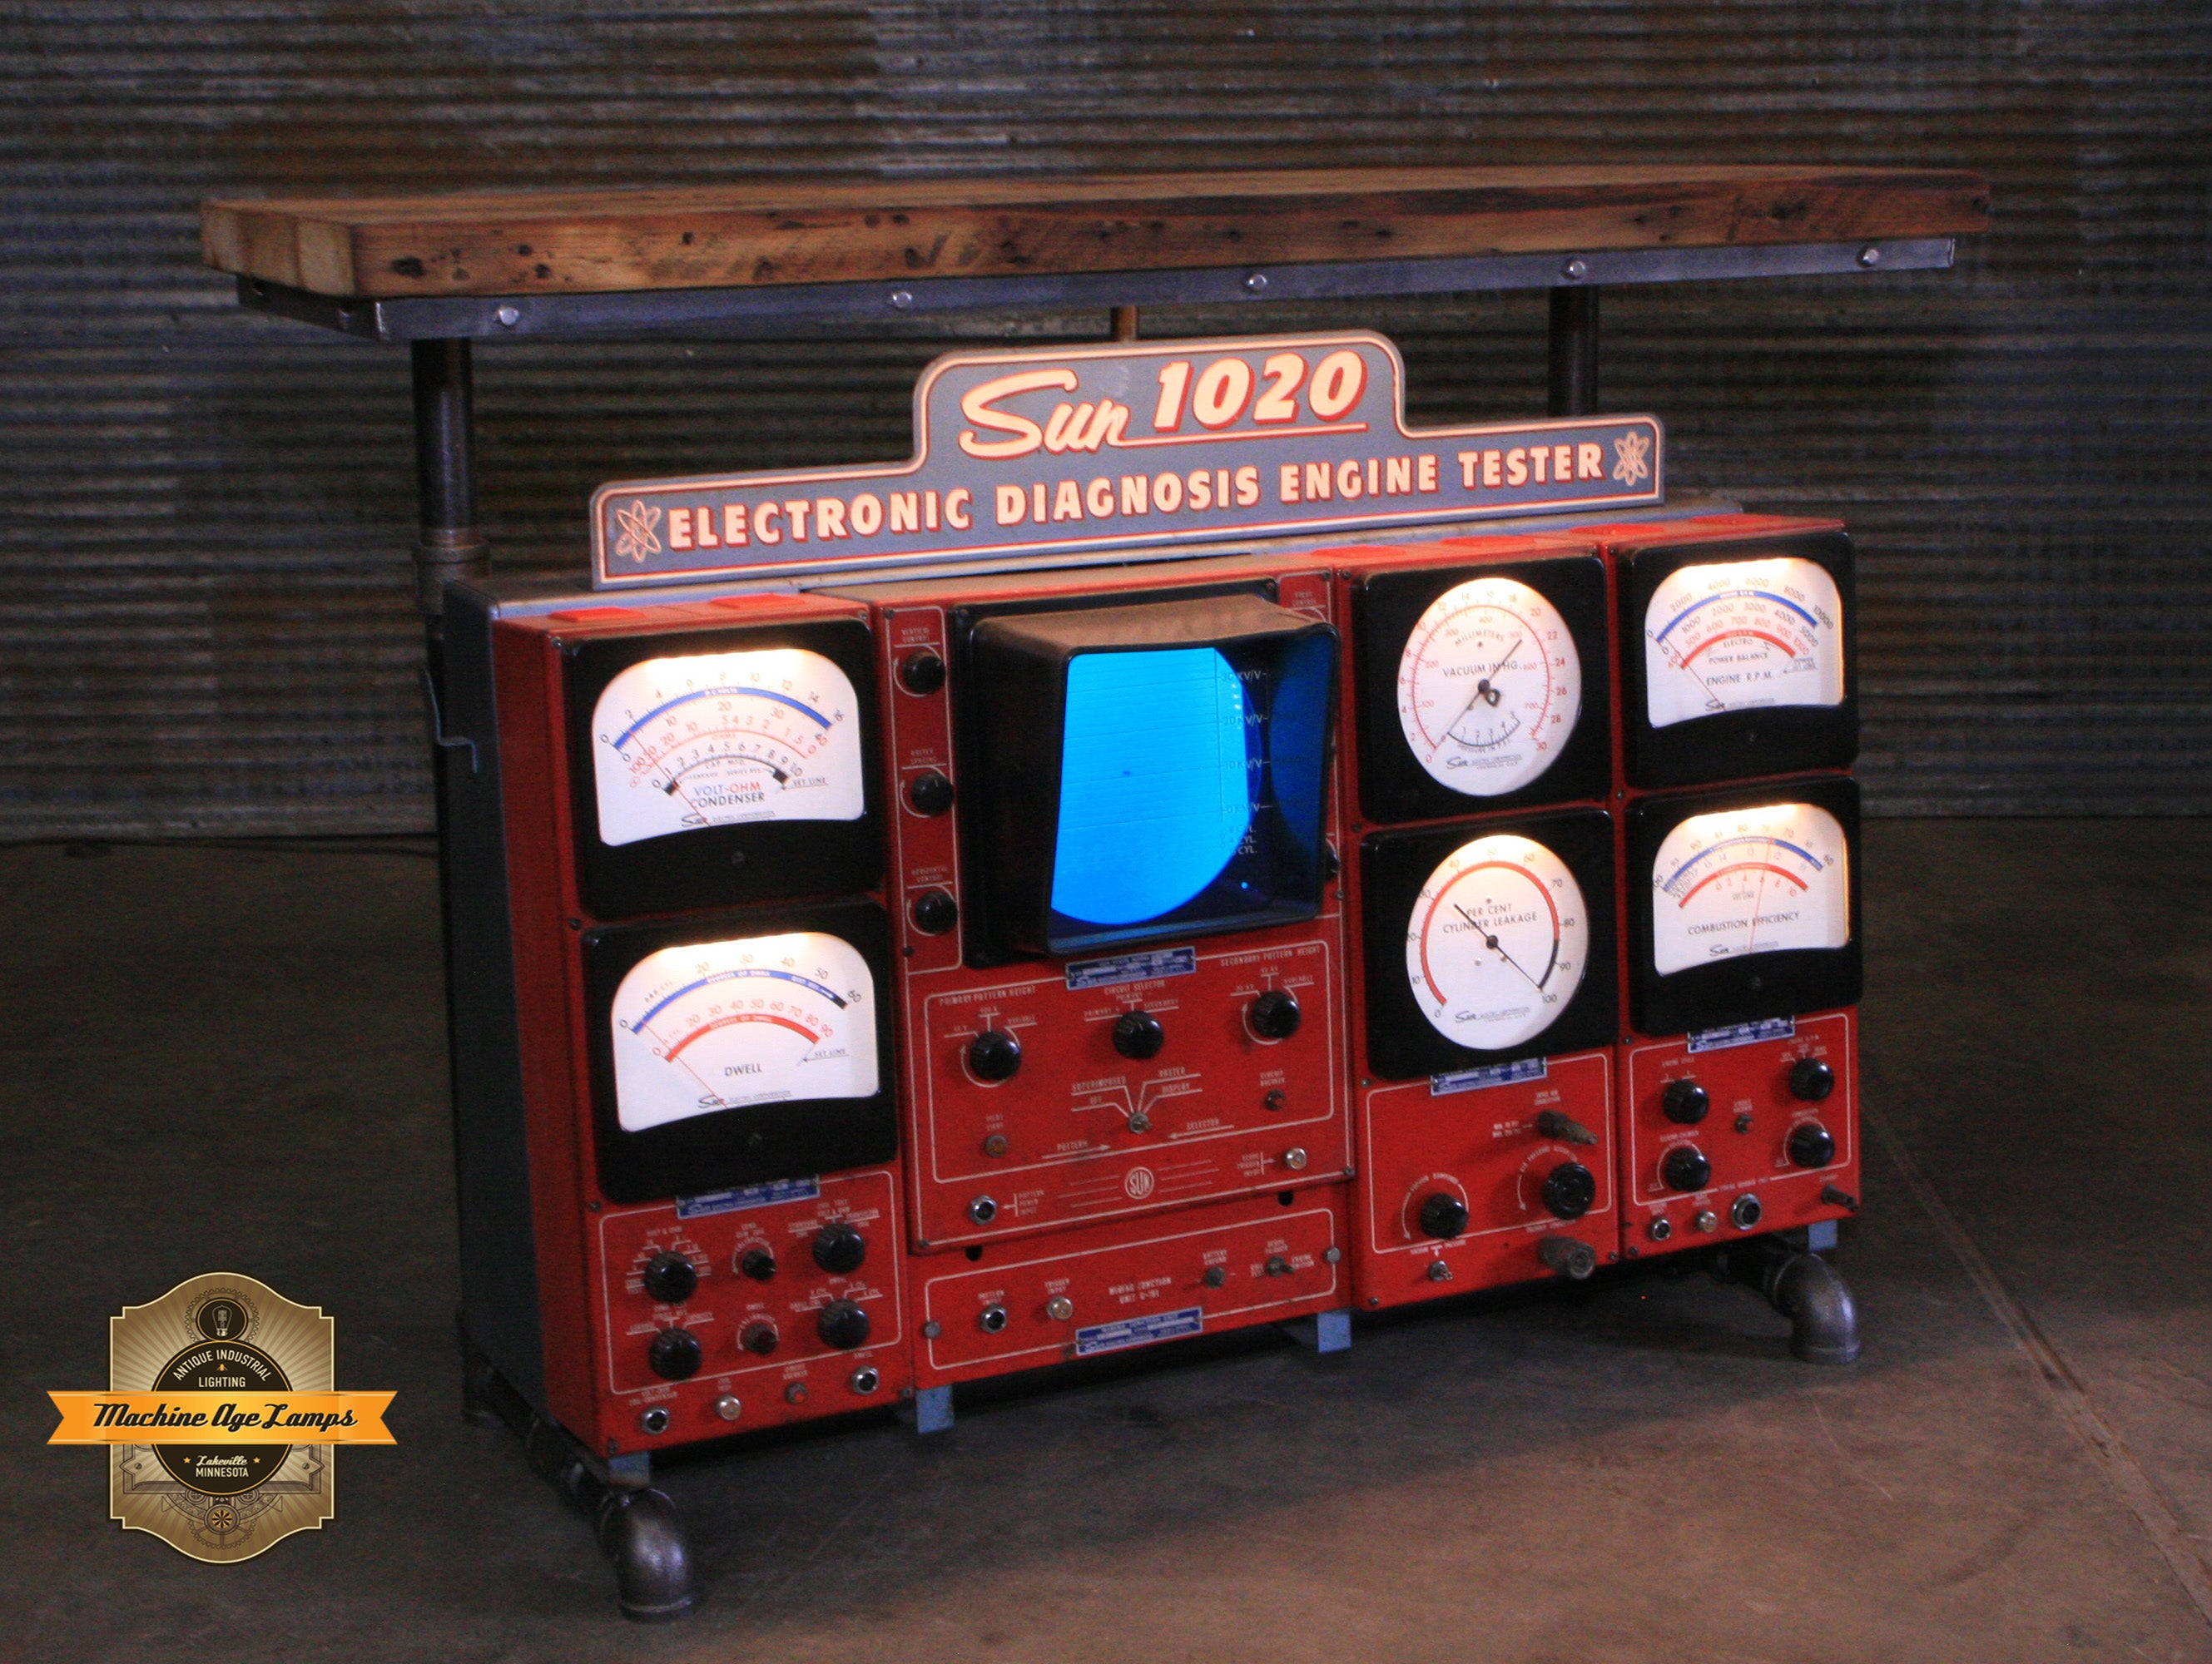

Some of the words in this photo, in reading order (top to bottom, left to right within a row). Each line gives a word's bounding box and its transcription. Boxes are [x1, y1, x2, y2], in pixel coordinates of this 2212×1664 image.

[958, 368, 1128, 460] Sun
[1153, 349, 1369, 433] 1020
[667, 488, 973, 551] ELECTRONIC
[996, 466, 1260, 527] DIAGNOSIS
[1279, 453, 1438, 503] ENGINE
[1458, 442, 1604, 490] TESTER
[1669, 593, 1693, 612] 2000
[1708, 578, 1730, 590] 4000
[1682, 617, 1701, 633] 1000
[1711, 602, 1734, 617] 2000
[1454, 630, 1504, 646] MILLIMETERS
[1547, 631, 1558, 640] 22
[1555, 658, 1565, 666] 24
[1709, 656, 1733, 664] POWER
[1737, 652, 1768, 662] BALANCE
[1442, 665, 1486, 677] VACUUM
[1707, 676, 1741, 686] ENGINE
[1556, 687, 1567, 696] 26
[625, 710, 633, 720] 2
[667, 716, 677, 726] 10
[718, 701, 731, 712] 20
[771, 709, 785, 720] 30
[1550, 715, 1561, 723] 28
[686, 721, 697, 732] 10
[732, 716, 739, 724] 4
[746, 716, 752, 725] 3
[763, 720, 770, 729] 2
[808, 745, 816, 755] 0
[652, 780, 662, 789] 0
[677, 757, 686, 767] 2
[692, 750, 700, 758] 3
[708, 745, 715, 753] 4
[723, 742, 730, 750] 5
[738, 741, 746, 750] 6
[755, 744, 761, 753] 7
[768, 749, 775, 758] 8
[780, 755, 788, 765] 9
[791, 764, 802, 776] 10
[809, 777, 826, 785] LINE
[691, 792, 765, 808] CONDENSER
[1551, 879, 1563, 888] 70
[1466, 908, 1484, 916] PER
[1488, 904, 1513, 914] CENT
[1443, 919, 1489, 934] CYLINDER
[1494, 913, 1537, 926] LEAKAGE
[1563, 919, 1575, 927] 80
[1688, 920, 1748, 935] COMBUSTION
[1753, 913, 1799, 927] EFFICIENCY
[1221, 954, 1260, 967] SECONDARY
[1263, 950, 1292, 960] PATTERN
[1297, 945, 1320, 956] HEIGHT
[1560, 962, 1571, 971] 90
[695, 962, 710, 974] 20
[815, 968, 828, 980] 50
[847, 990, 861, 1003] 60
[1542, 994, 1557, 1003] 100
[686, 1014, 701, 1027] 20
[708, 1005, 722, 1016] 30
[730, 1000, 744, 1009] 40
[751, 999, 765, 1009] 50
[770, 1000, 785, 1011] 60
[790, 1006, 802, 1018] 70
[805, 1013, 819, 1027] 80
[822, 1027, 834, 1038] 90
[724, 1064, 762, 1077] DWELL
[1129, 1173, 1150, 1194] SUN
